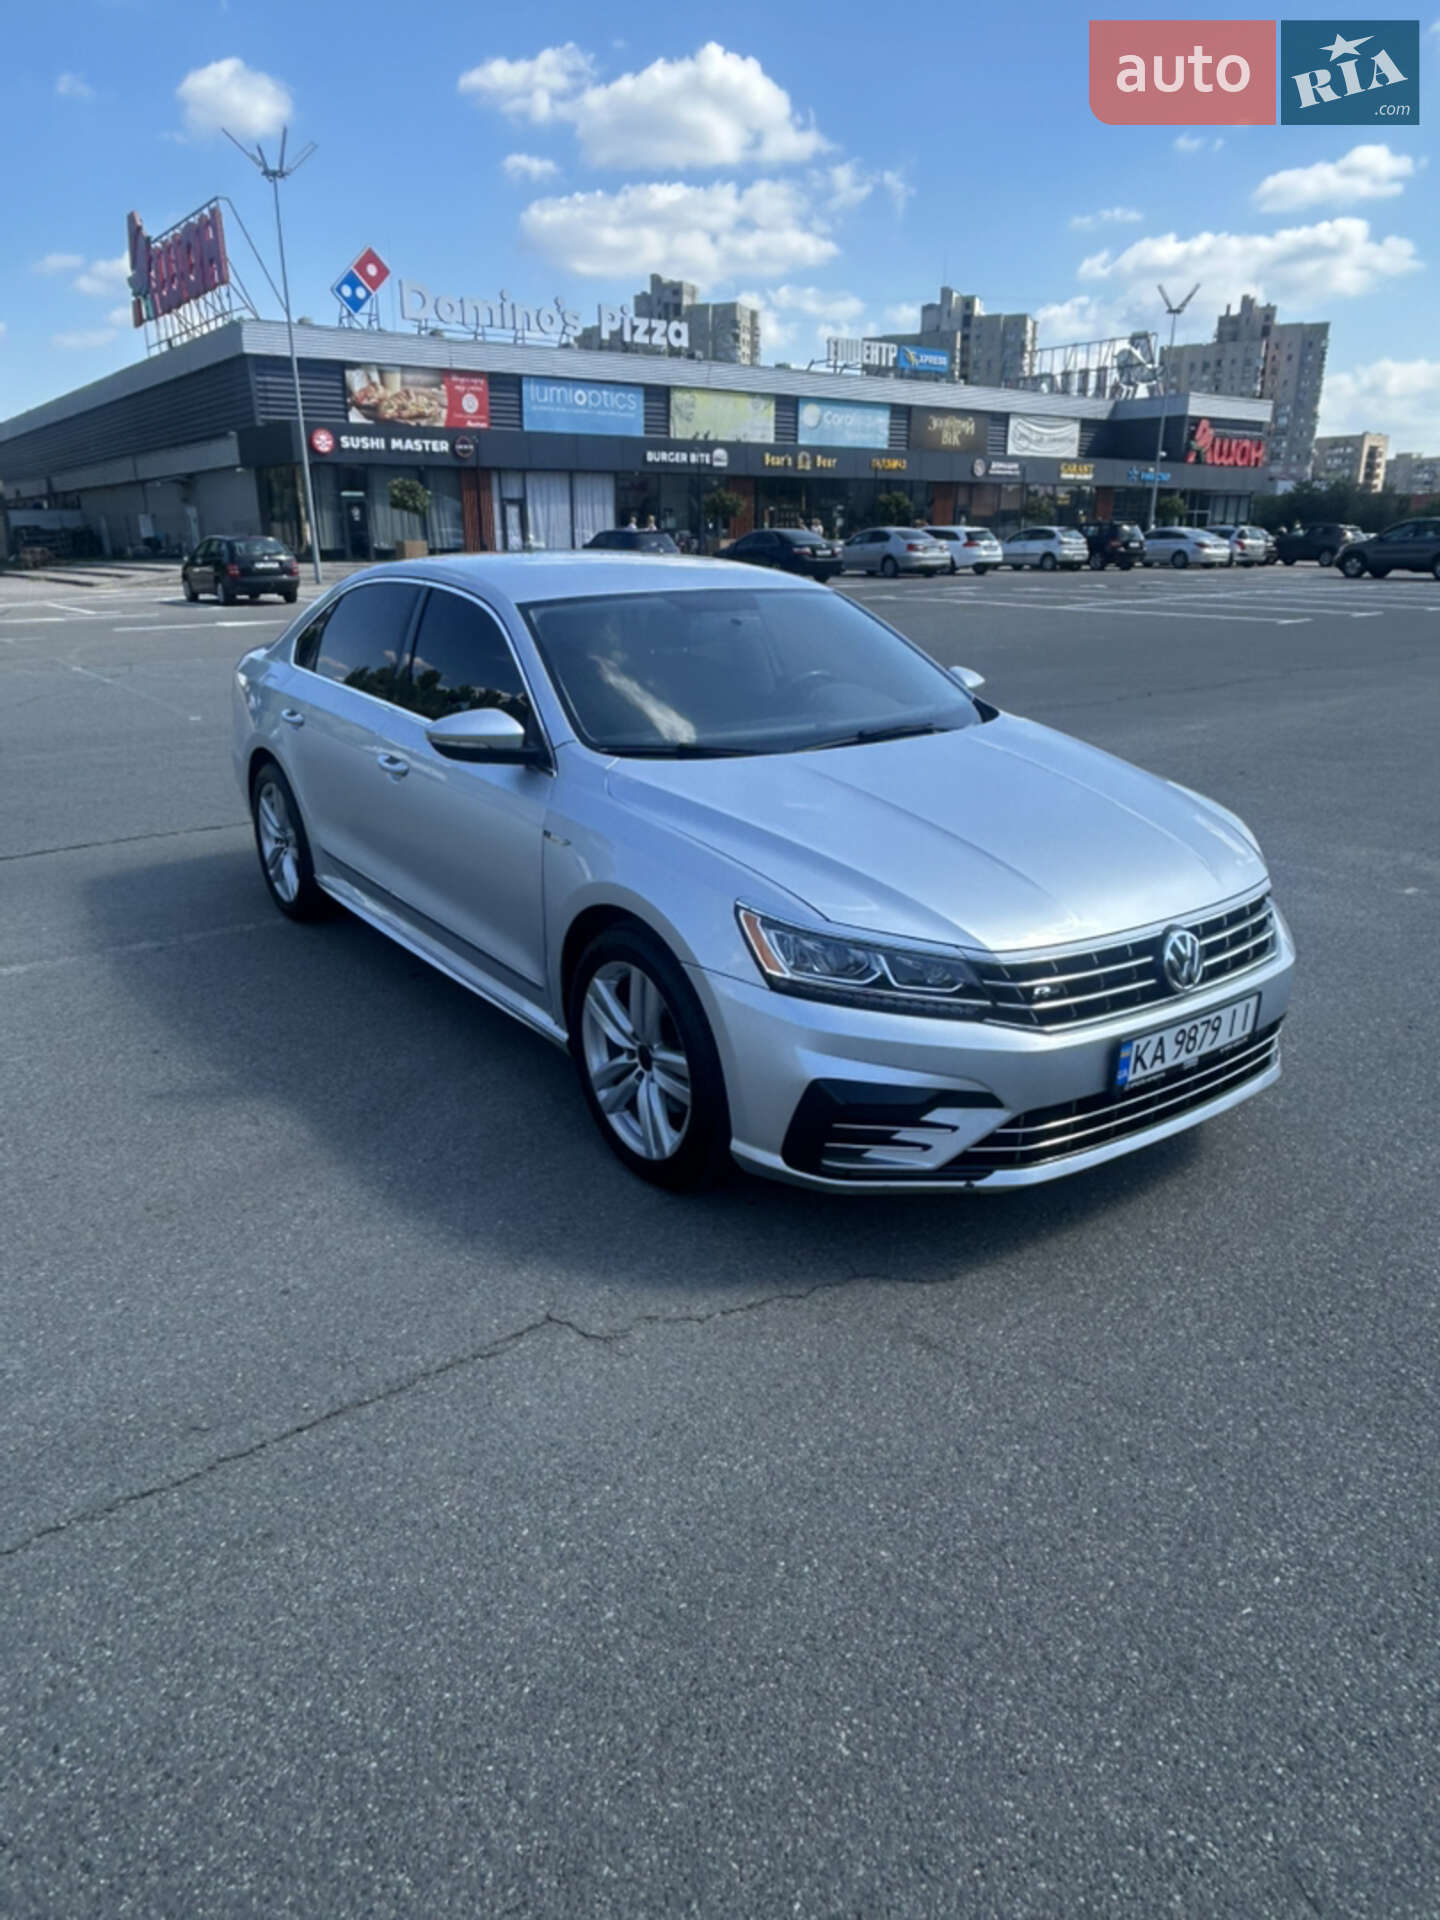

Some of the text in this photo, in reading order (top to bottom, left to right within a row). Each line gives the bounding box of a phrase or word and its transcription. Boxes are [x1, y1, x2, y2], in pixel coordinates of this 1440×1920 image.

[398, 278, 690, 348] Domino's Pizza
[529, 377, 638, 410] lumioptics
[340, 435, 385, 450] SUSHI
[390, 437, 449, 453] MASTER
[646, 450, 688, 464] BURGER
[1132, 1036, 1165, 1075] KA
[1173, 1015, 1223, 1061] 9879
